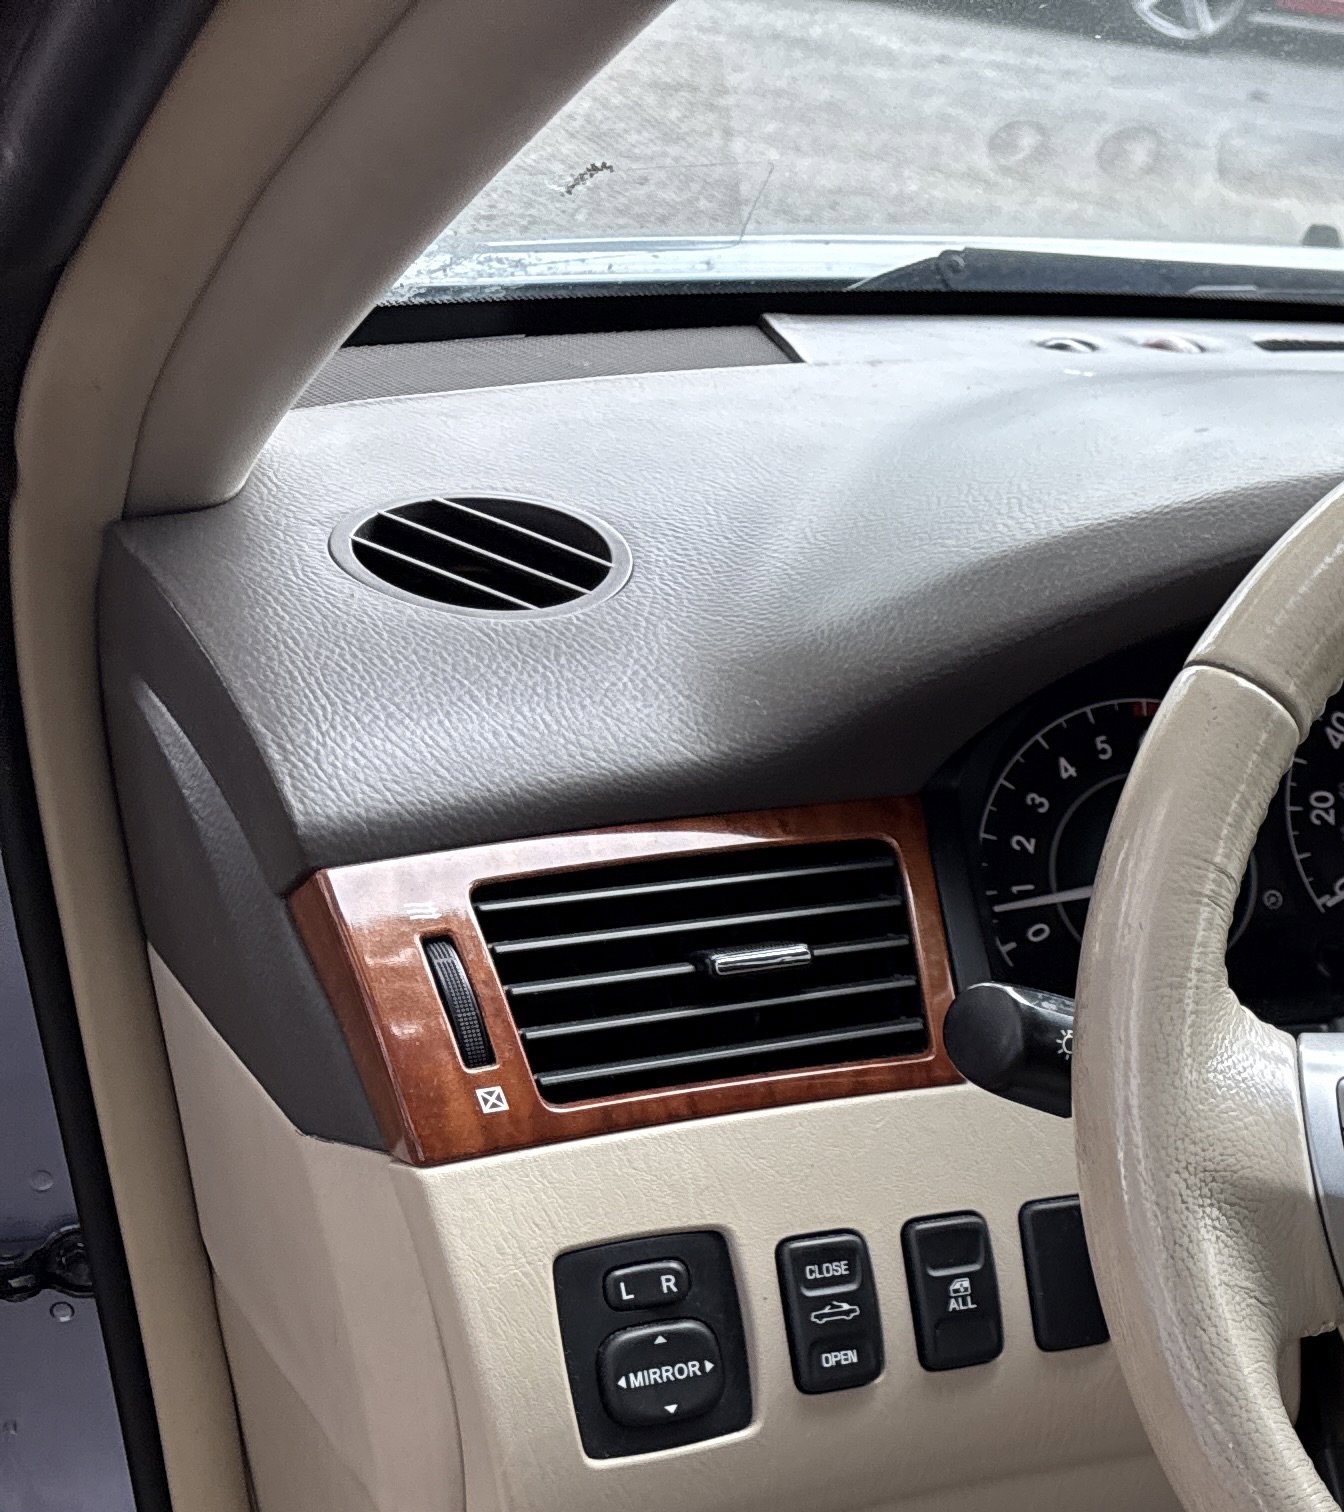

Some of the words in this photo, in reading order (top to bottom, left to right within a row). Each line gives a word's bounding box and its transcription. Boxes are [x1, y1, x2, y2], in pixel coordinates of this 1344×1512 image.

[1095, 735, 1113, 760] 5
[1057, 757, 1078, 781] 4
[1026, 792, 1049, 815] 3
[1310, 791, 1335, 826] 20
[1011, 834, 1035, 855] 2
[1011, 882, 1035, 895] 1
[1026, 923, 1050, 944] 0
[804, 1260, 850, 1280] CLOSE
[619, 1281, 634, 1301] L
[659, 1273, 679, 1294] R
[947, 1295, 977, 1312] ALL
[821, 1349, 858, 1369] OPEN
[629, 1361, 702, 1390] MIRROR
